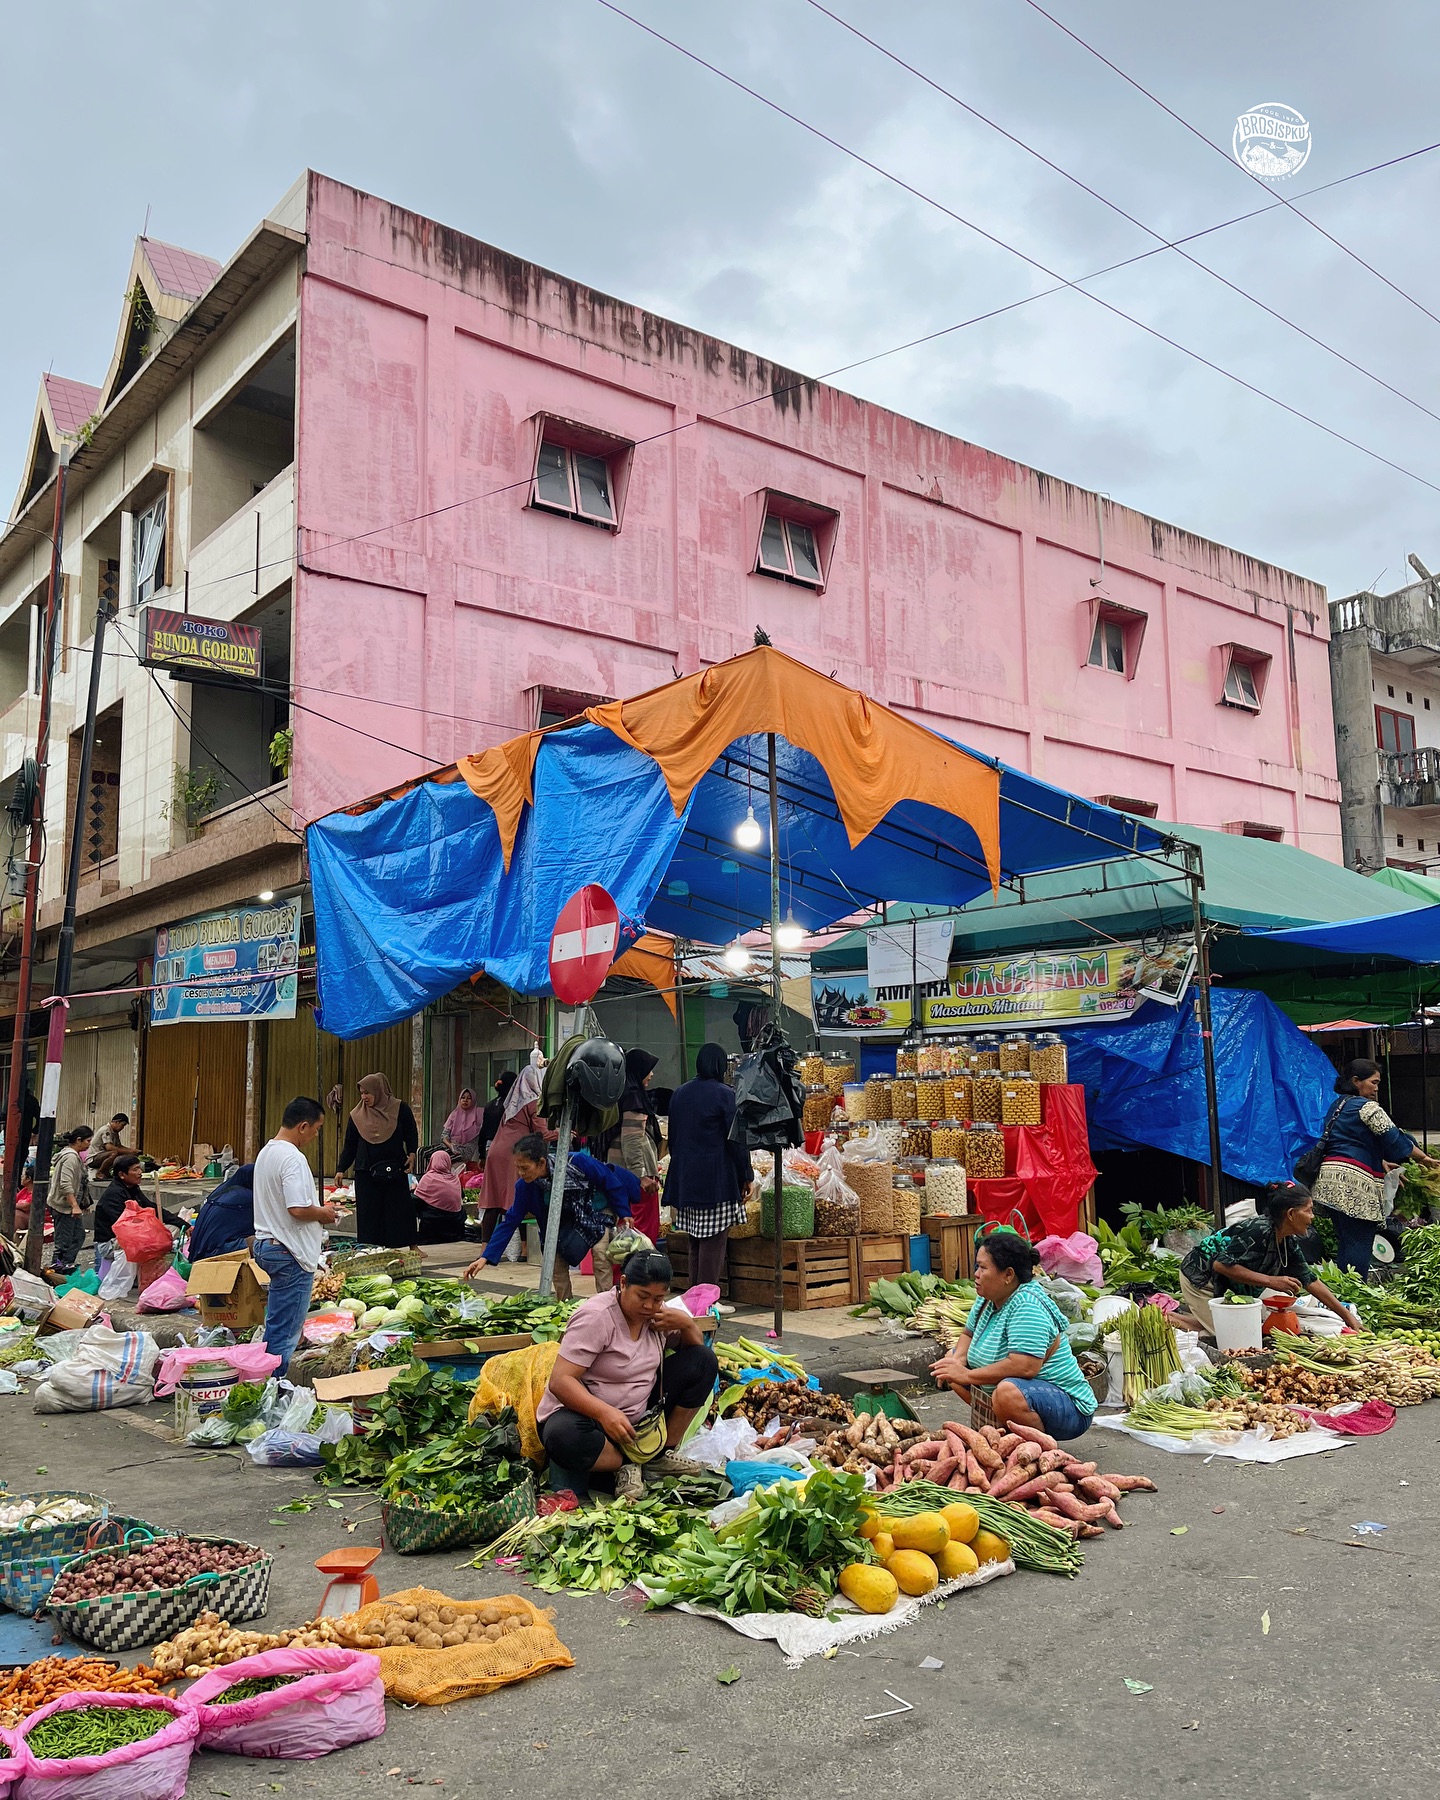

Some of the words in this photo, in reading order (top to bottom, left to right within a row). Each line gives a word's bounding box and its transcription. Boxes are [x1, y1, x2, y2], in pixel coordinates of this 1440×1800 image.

[183, 621, 227, 639] TOKO
[154, 631, 199, 655] BUNDA
[201, 639, 256, 665] GORDEN
[169, 923, 198, 951] TOKO
[200, 915, 240, 946] BUNDA
[242, 906, 297, 940] GORDEN
[930, 1002, 991, 1020] Masakan
[1100, 999, 1126, 1011] 0823
[192, 1388, 230, 1402] LEKTO
